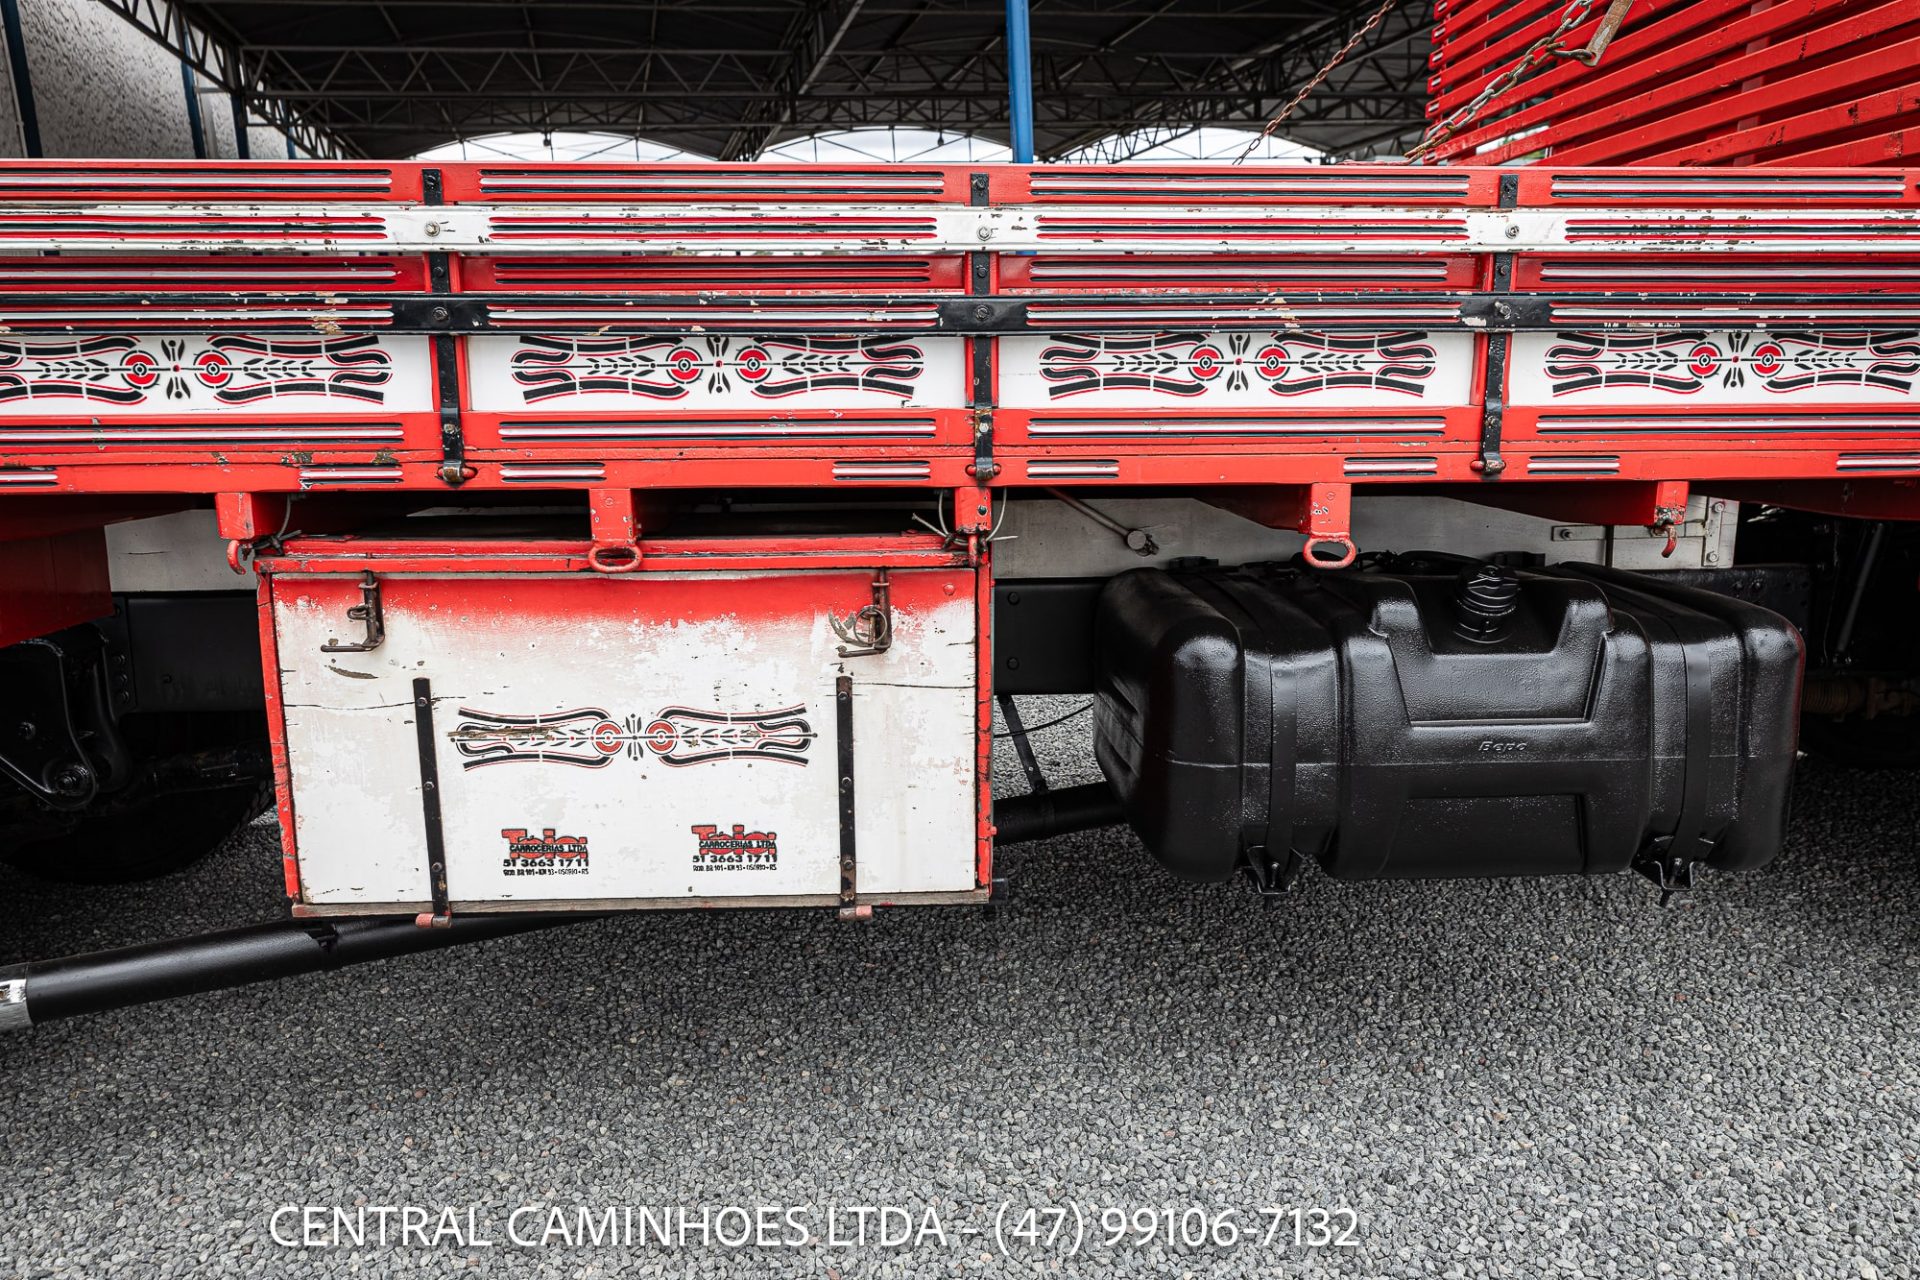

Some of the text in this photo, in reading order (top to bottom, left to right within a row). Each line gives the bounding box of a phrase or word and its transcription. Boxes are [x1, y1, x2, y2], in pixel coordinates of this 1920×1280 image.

[509, 844, 588, 853] CARROCERIAS LTDA
[699, 840, 777, 849] CARROCERIAS LTDA
[692, 854, 777, 863] 51 3663 1711
[503, 859, 589, 868] 51 3663 1711
